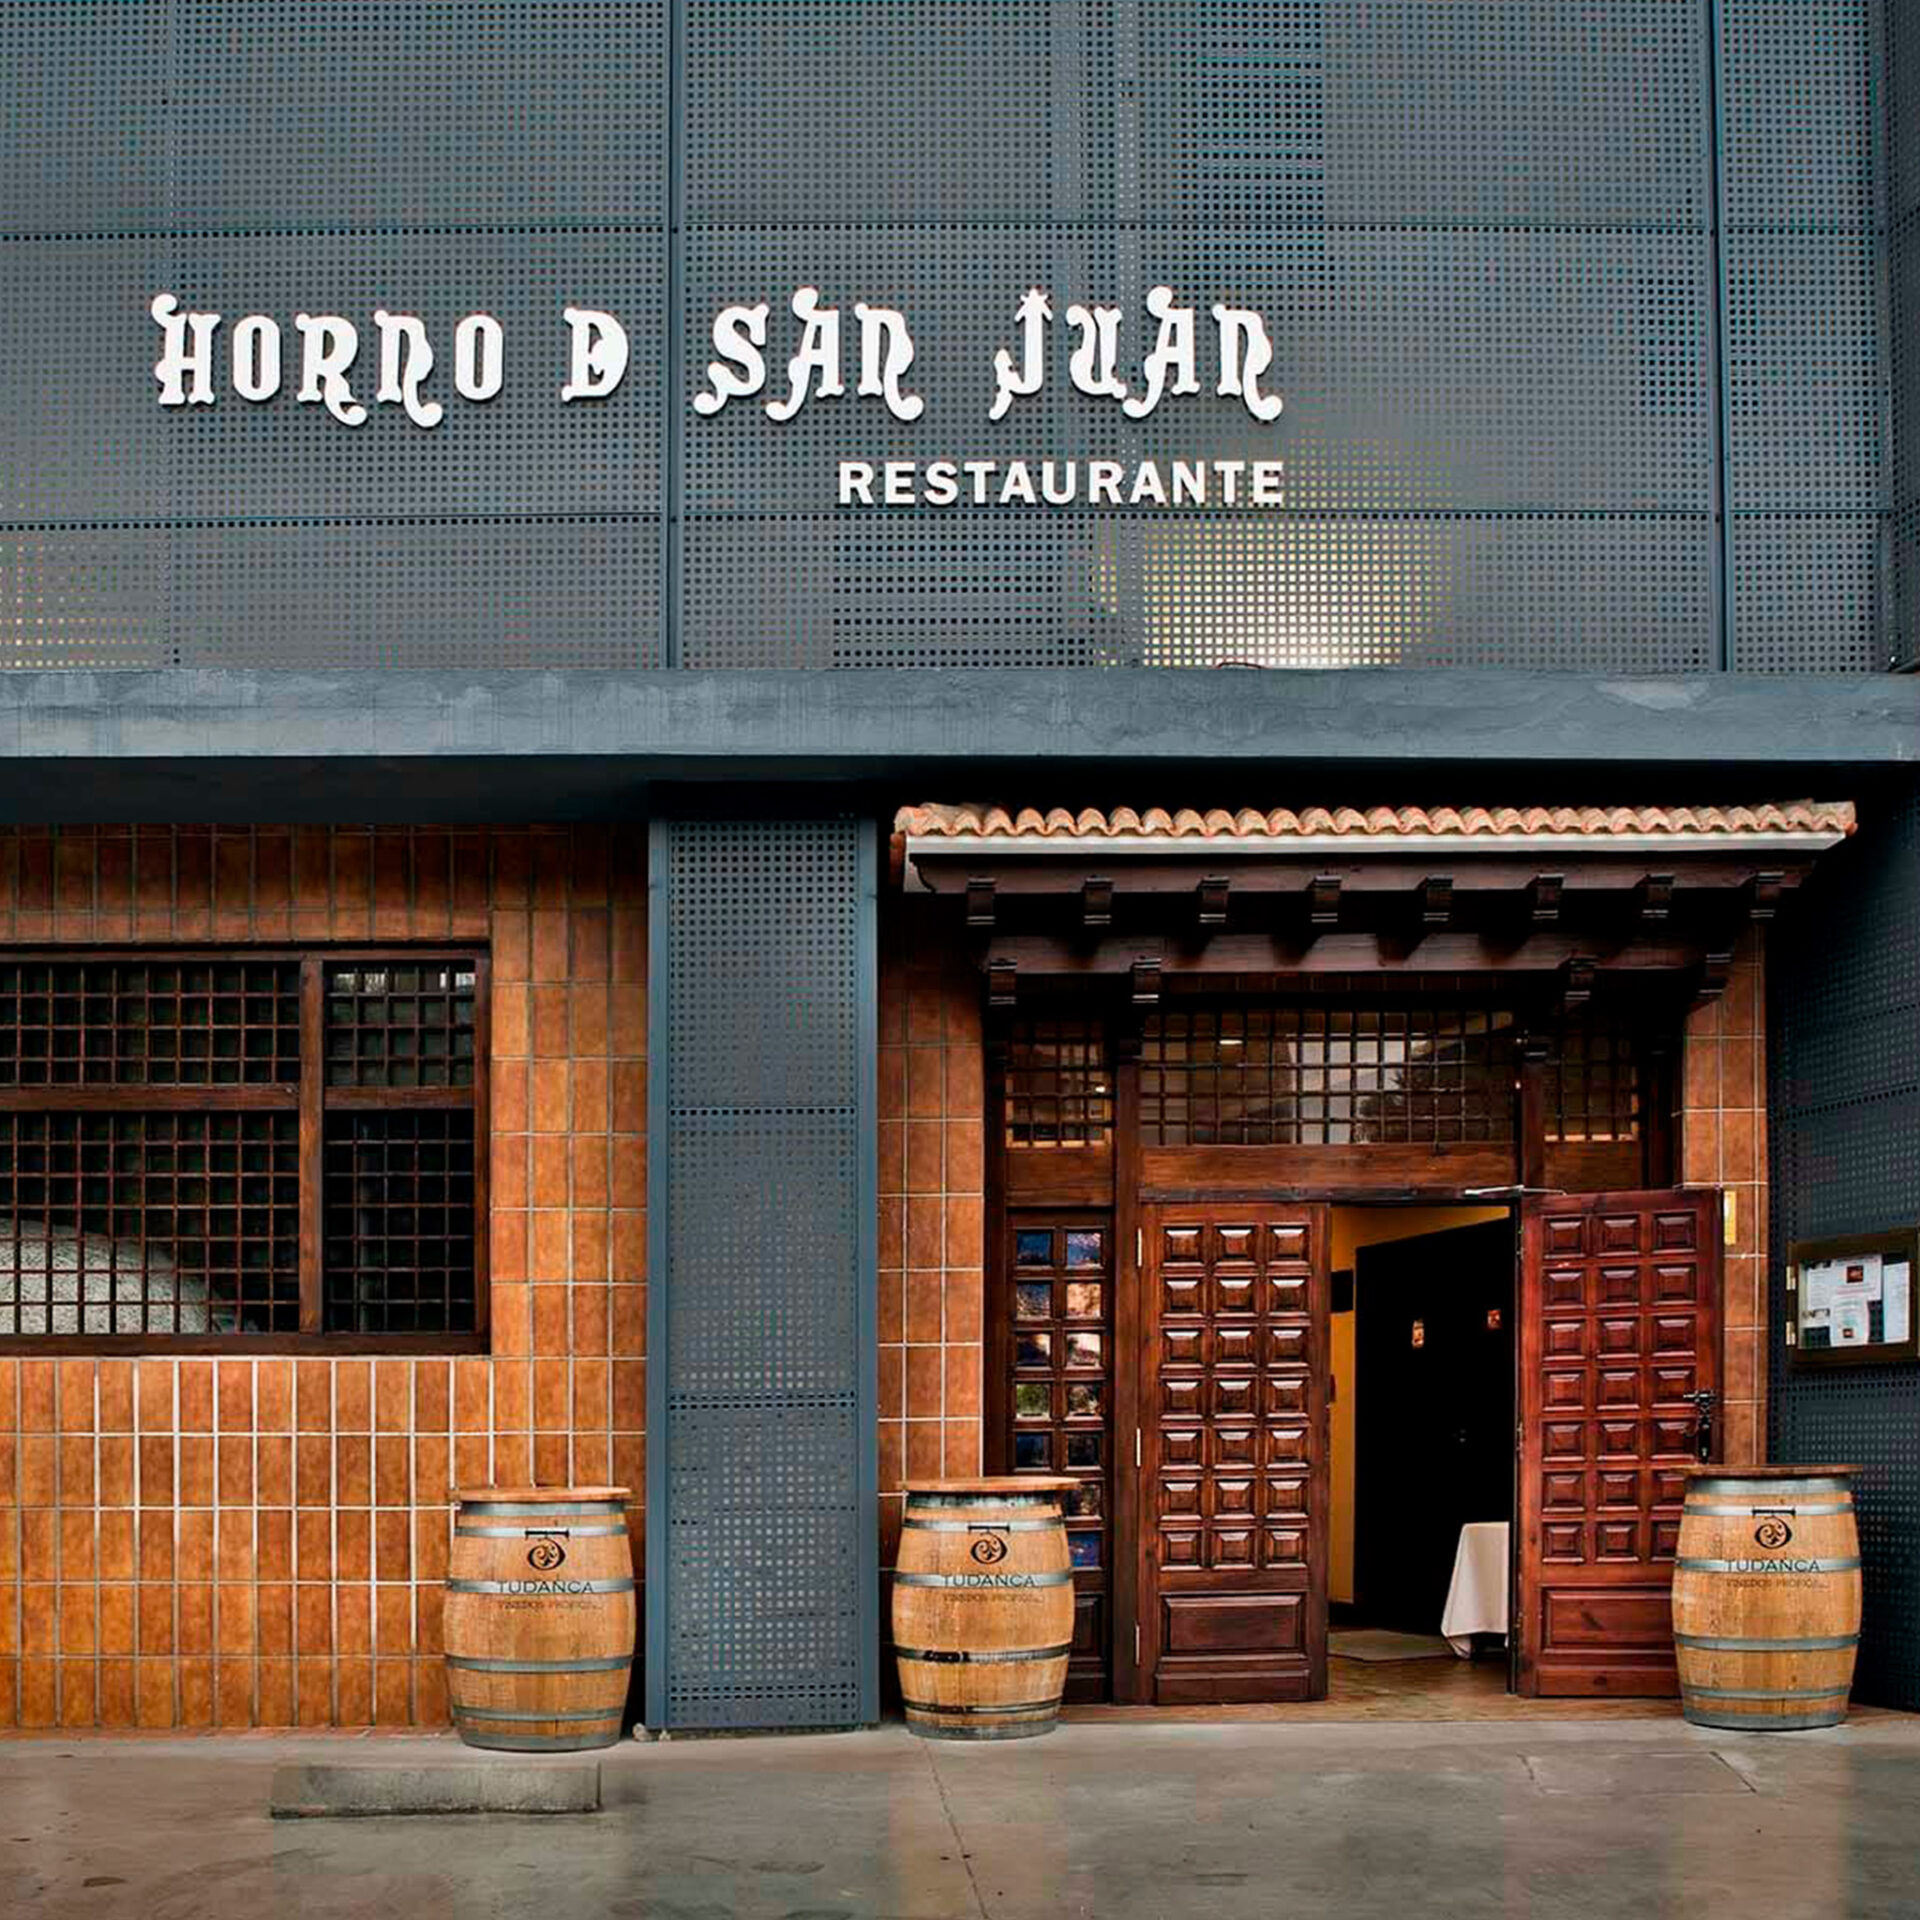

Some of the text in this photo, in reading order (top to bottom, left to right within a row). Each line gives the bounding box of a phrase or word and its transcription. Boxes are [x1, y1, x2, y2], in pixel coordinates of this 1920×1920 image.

[152, 294, 503, 426] HORNO
[694, 287, 923, 420] SAN
[990, 288, 1283, 420] JUAN
[839, 461, 1283, 505] RESTAURANTE
[1728, 1560, 1821, 1573] TUDANCA
[498, 1580, 595, 1594] TUDANCA
[943, 1575, 1036, 1588] TUDANCA
